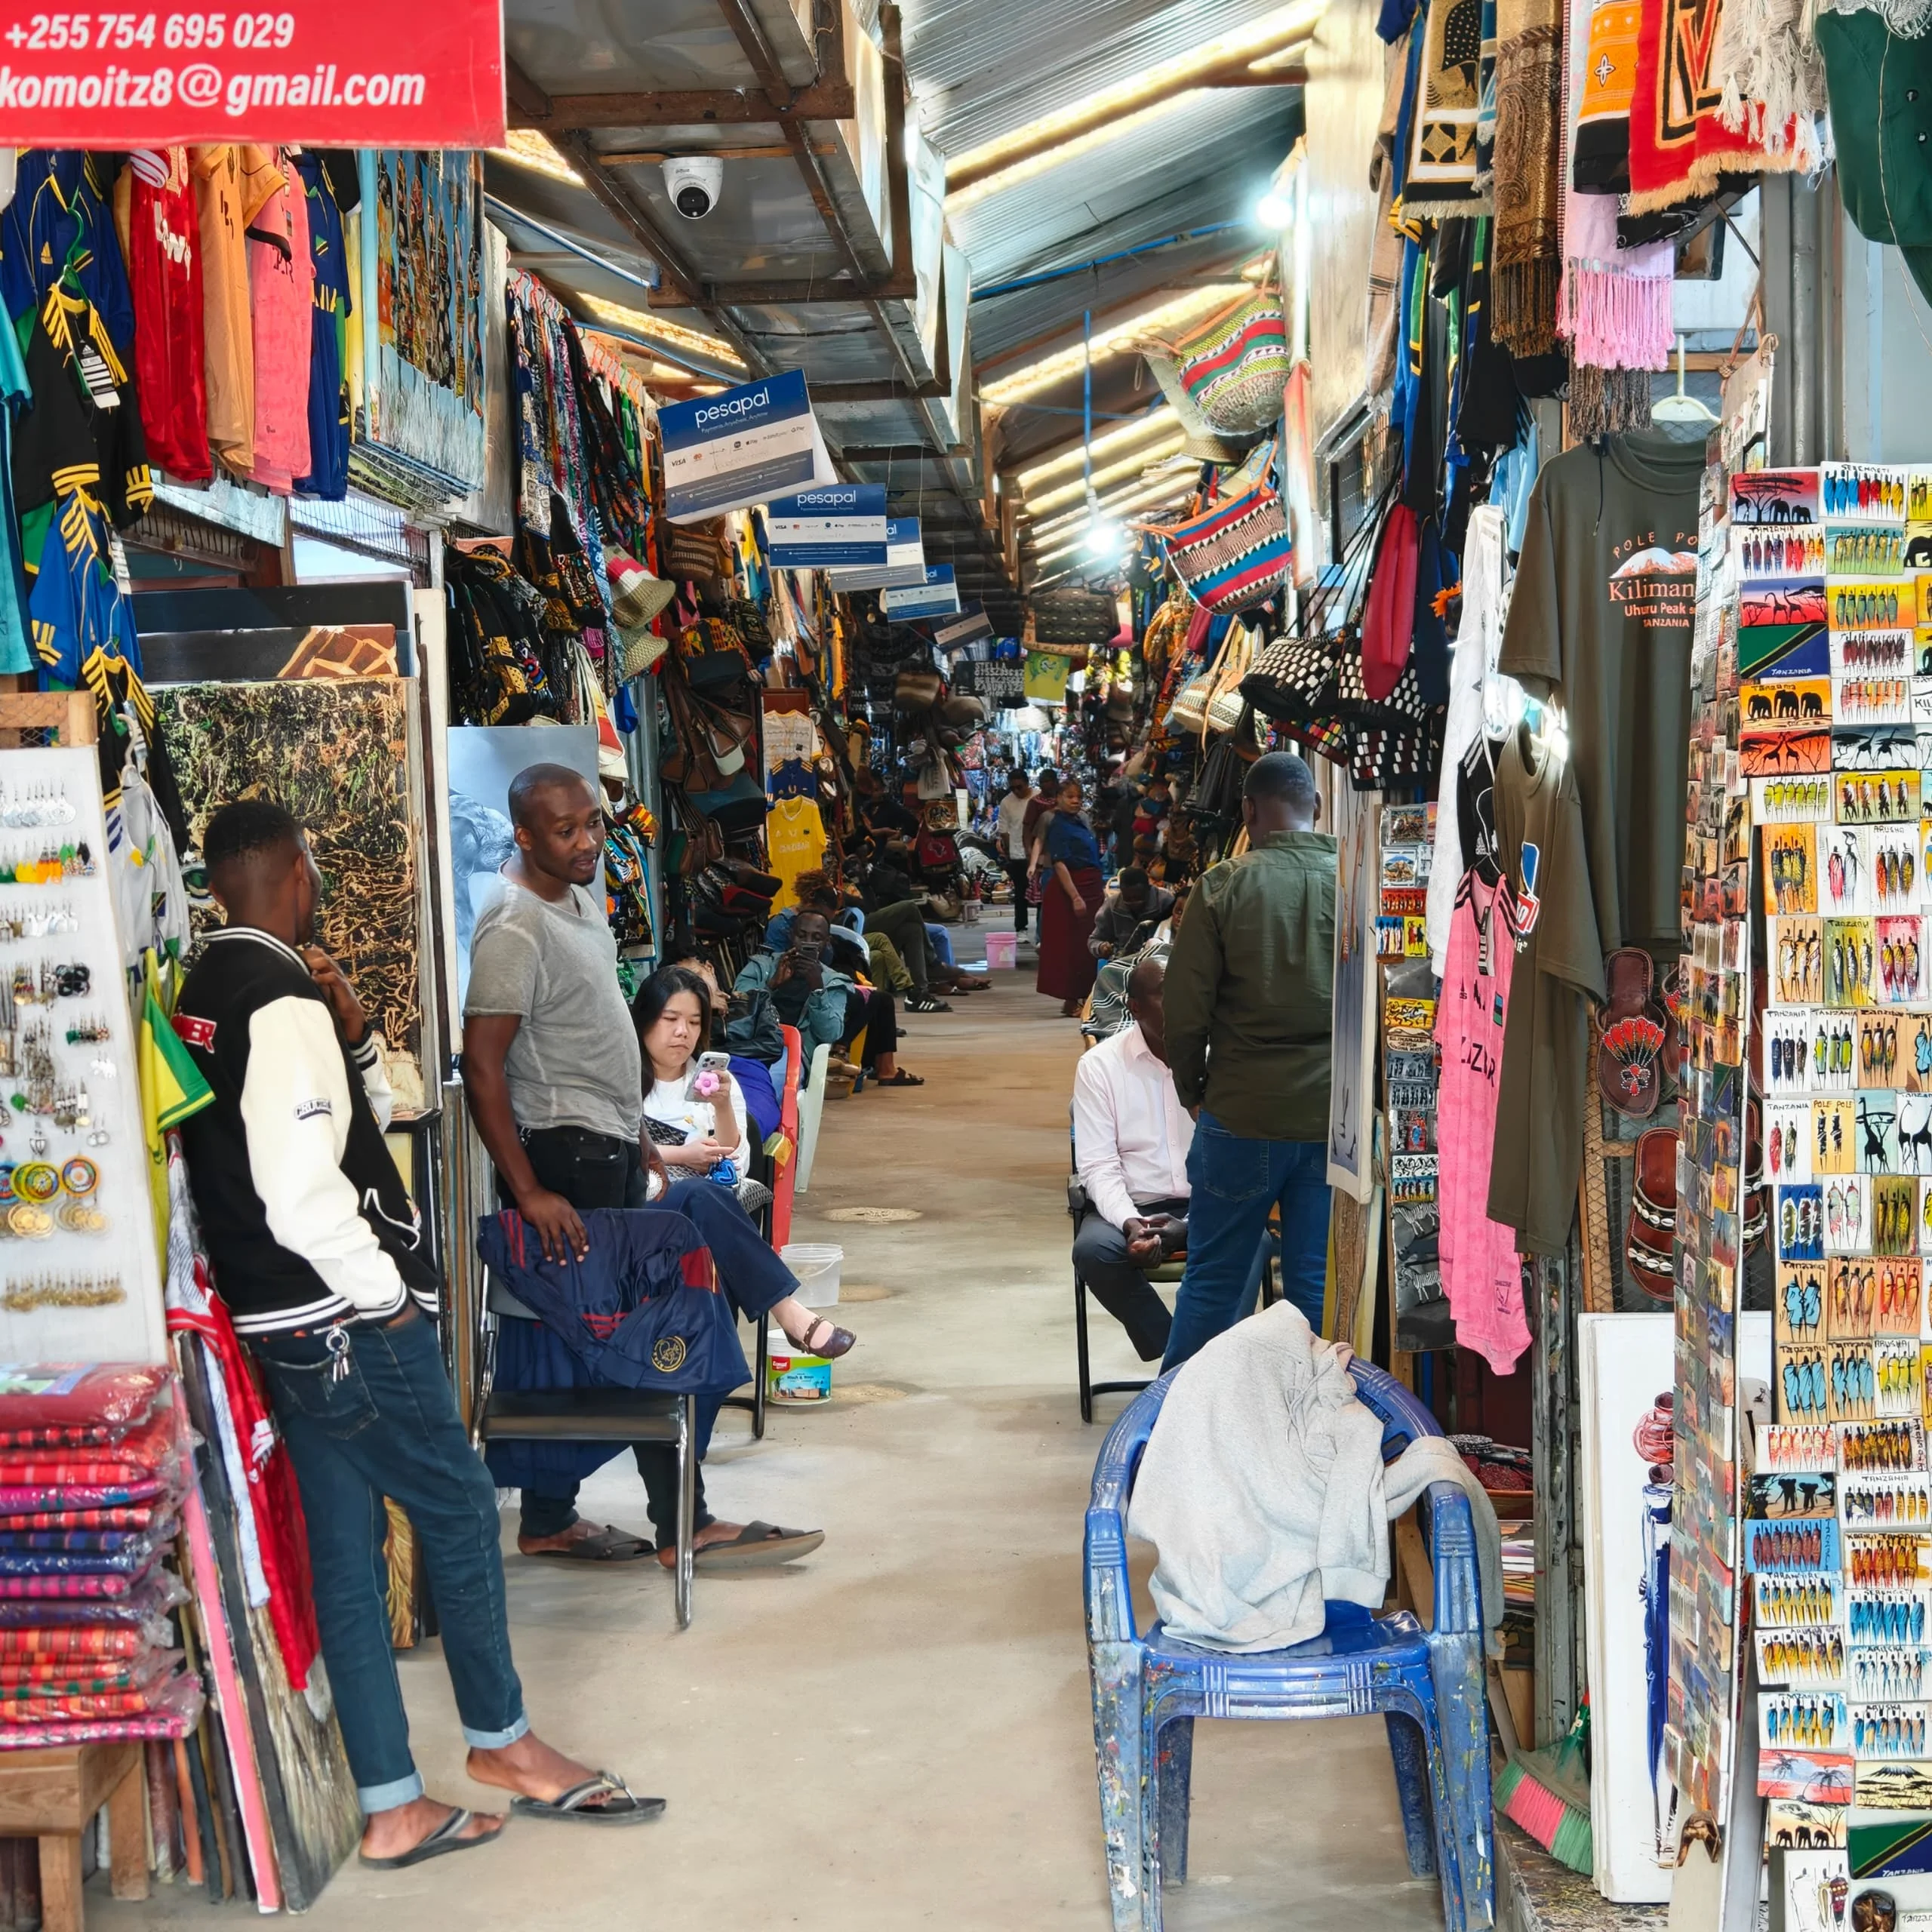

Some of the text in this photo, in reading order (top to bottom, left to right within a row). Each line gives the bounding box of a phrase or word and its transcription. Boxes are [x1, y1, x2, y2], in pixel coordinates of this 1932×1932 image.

[5, 13, 295, 48] +255 754 695 029
[694, 387, 770, 428] pesapal
[671, 457, 687, 468] VISA
[797, 490, 856, 506] pesapal
[1612, 531, 1655, 559] POLE
[1624, 604, 1657, 617] Uhuru
[1660, 601, 1687, 615] Peak
[1642, 618, 1690, 628] TANZANIA
[1767, 1103, 1810, 1112] TANZANIA
